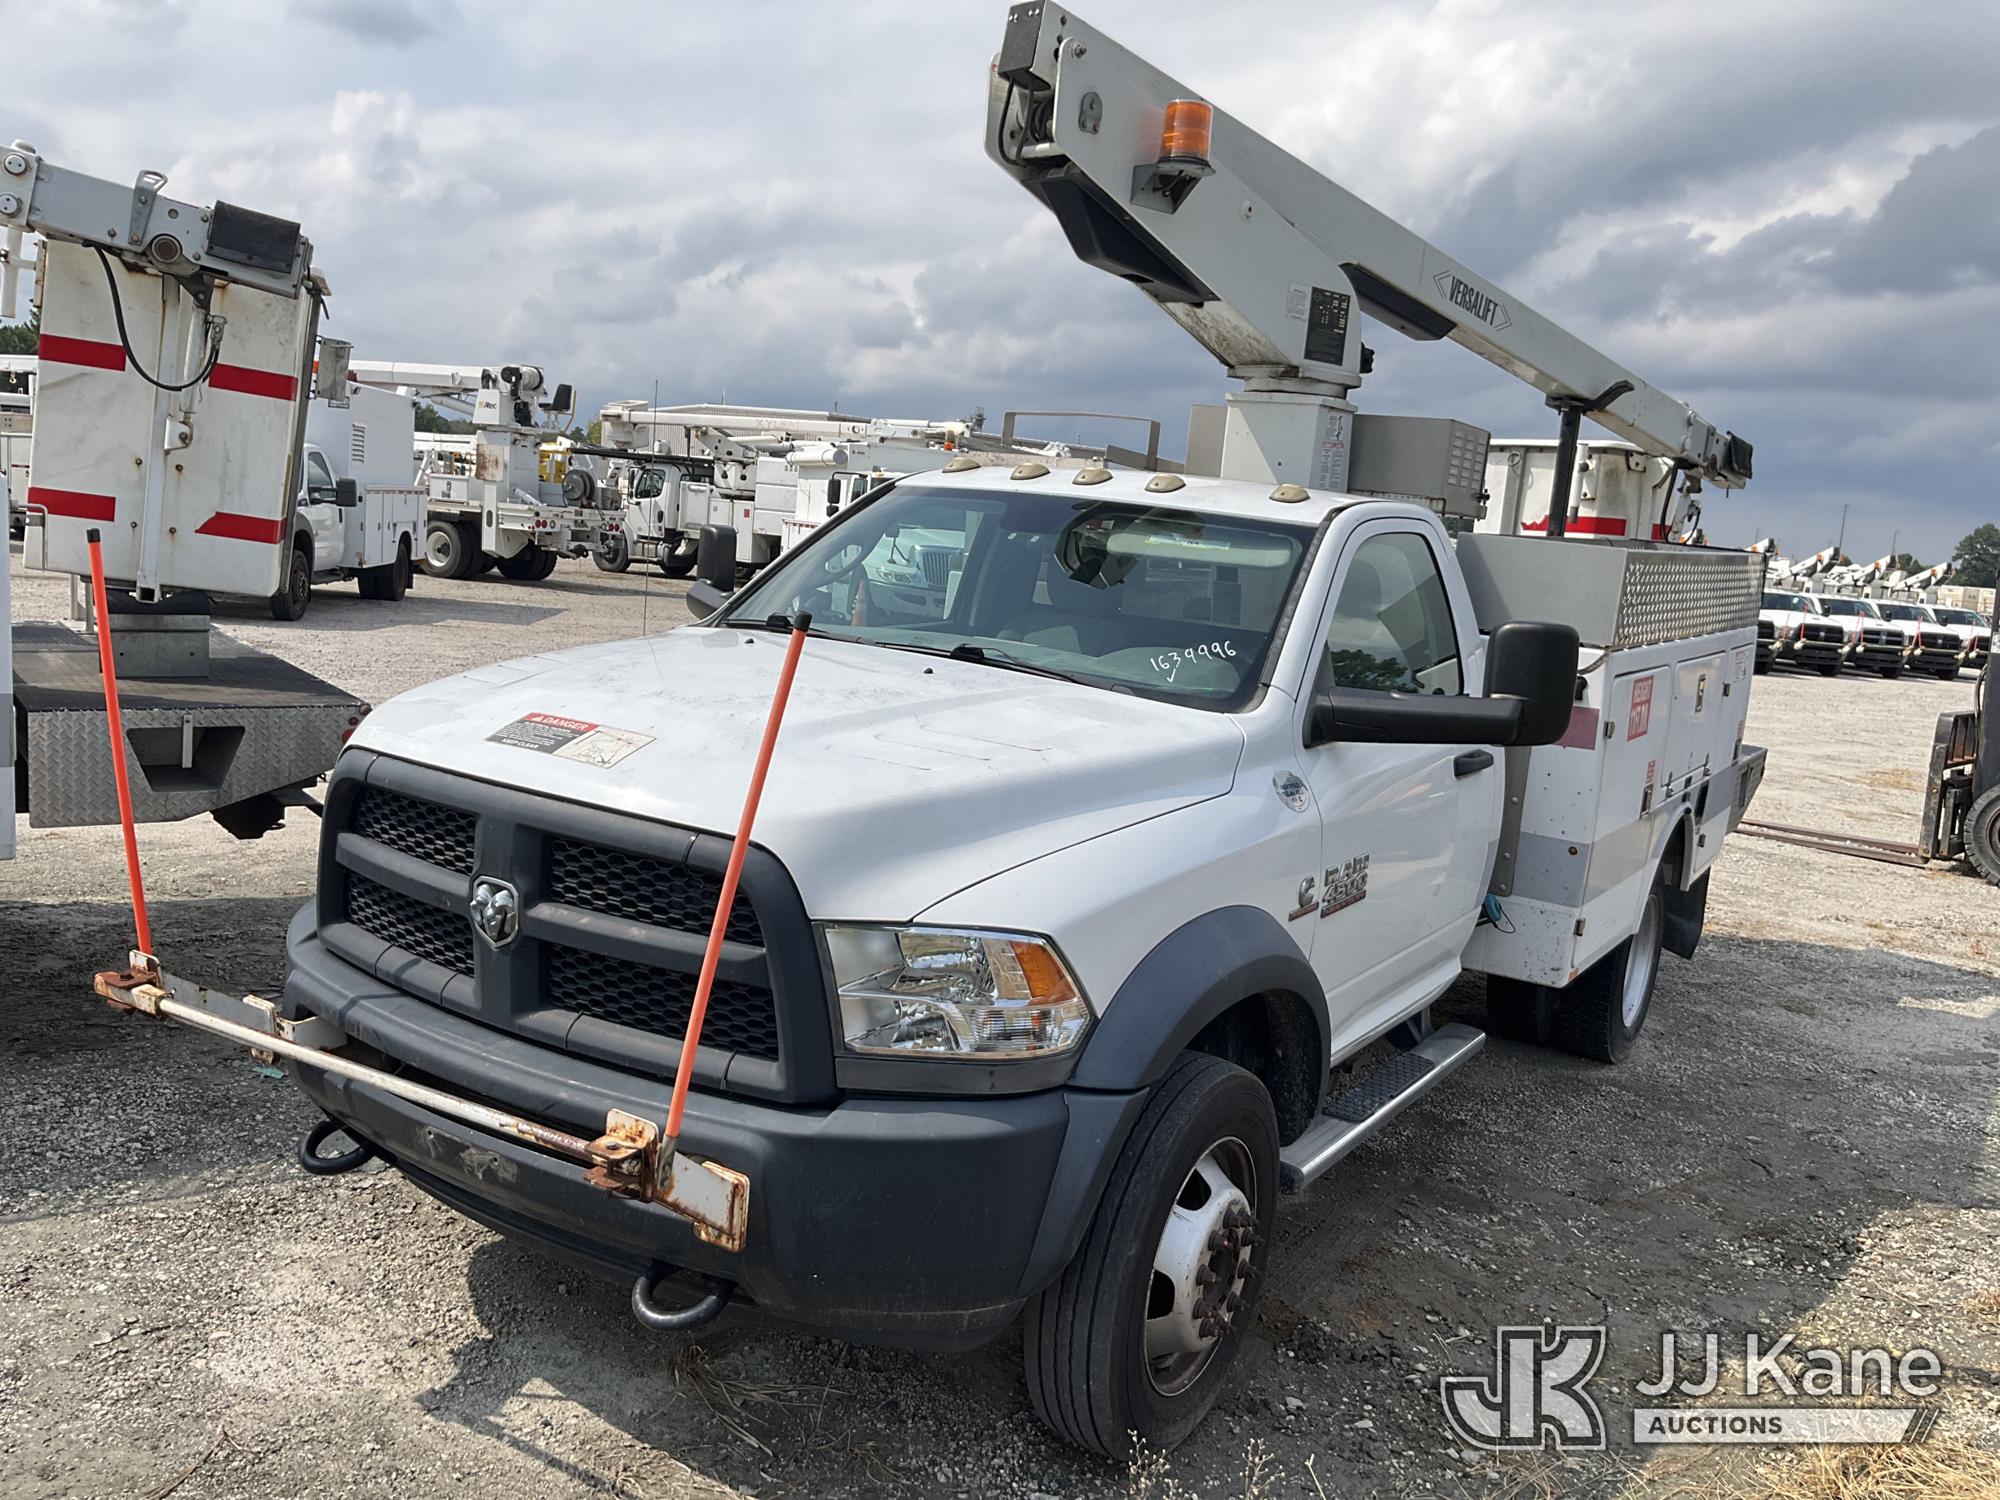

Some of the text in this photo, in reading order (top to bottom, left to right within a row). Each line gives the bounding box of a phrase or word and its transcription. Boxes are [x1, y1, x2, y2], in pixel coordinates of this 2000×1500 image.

[1449, 275, 1499, 327] VERSALIFT
[1150, 641, 1237, 671] 1639996
[543, 716, 589, 731] DANGER
